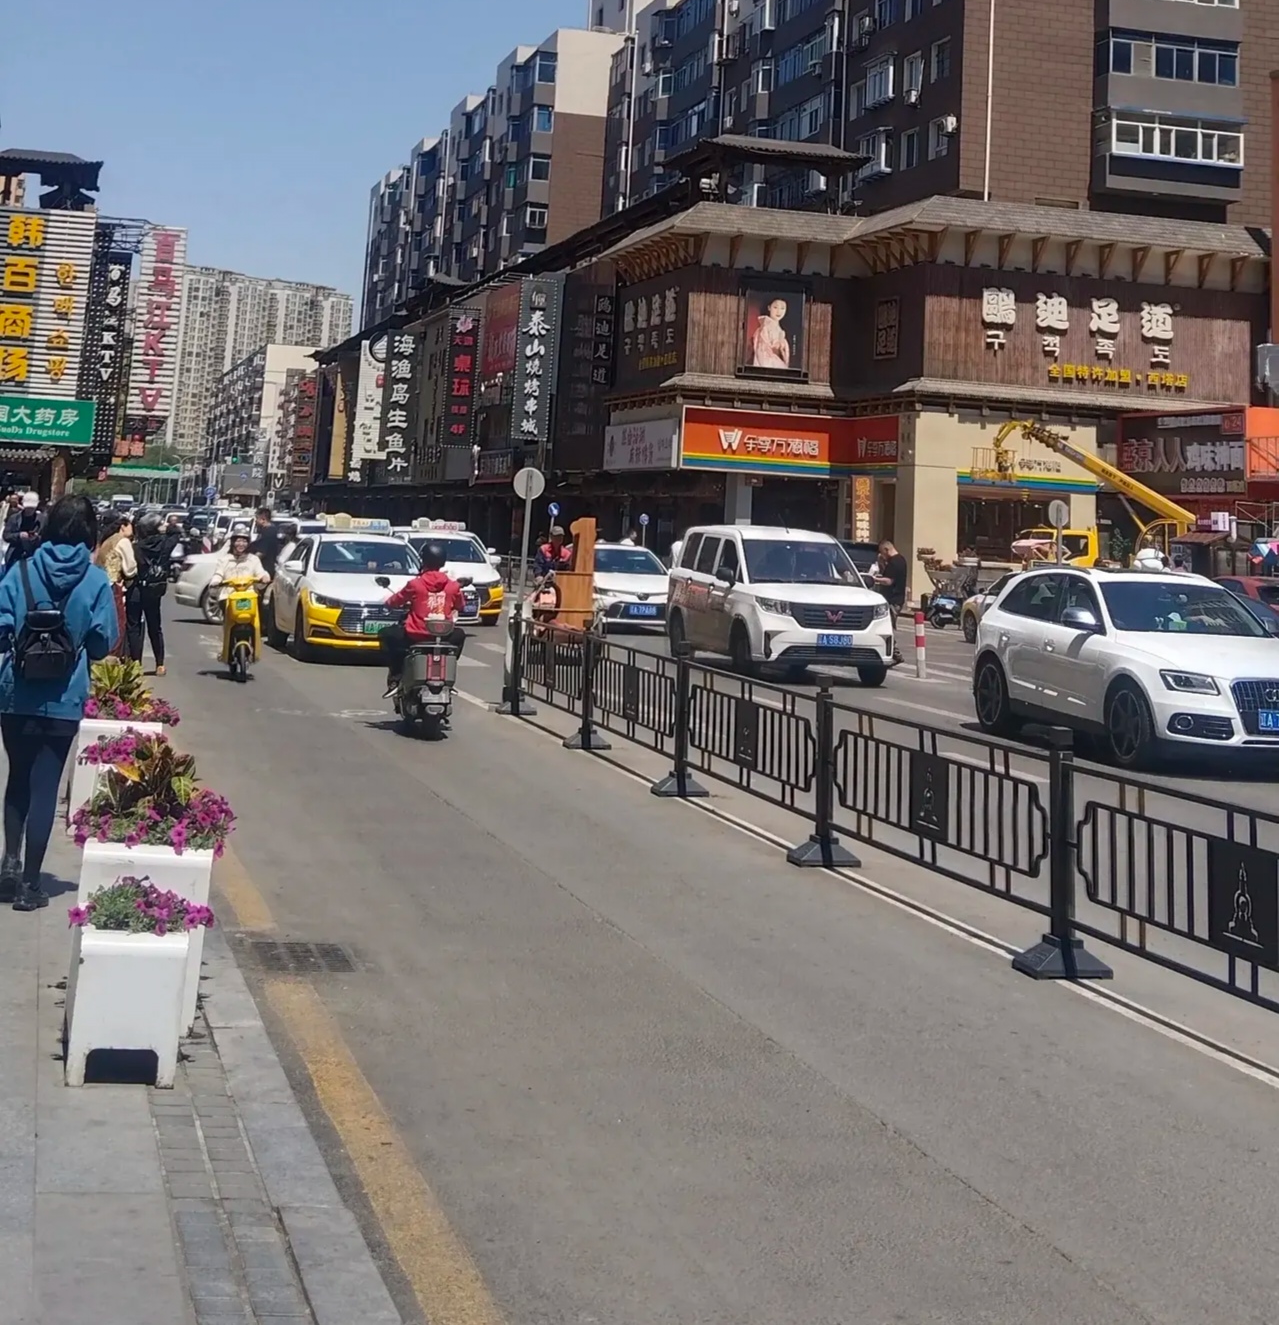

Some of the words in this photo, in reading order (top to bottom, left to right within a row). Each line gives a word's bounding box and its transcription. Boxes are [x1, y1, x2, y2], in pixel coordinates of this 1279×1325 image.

[0, 214, 46, 382] 韩百商场
[986, 330, 1171, 364] 구적족도
[26, 426, 70, 438] Drugstore
[384, 334, 416, 472] 海渔岛生鱼片
